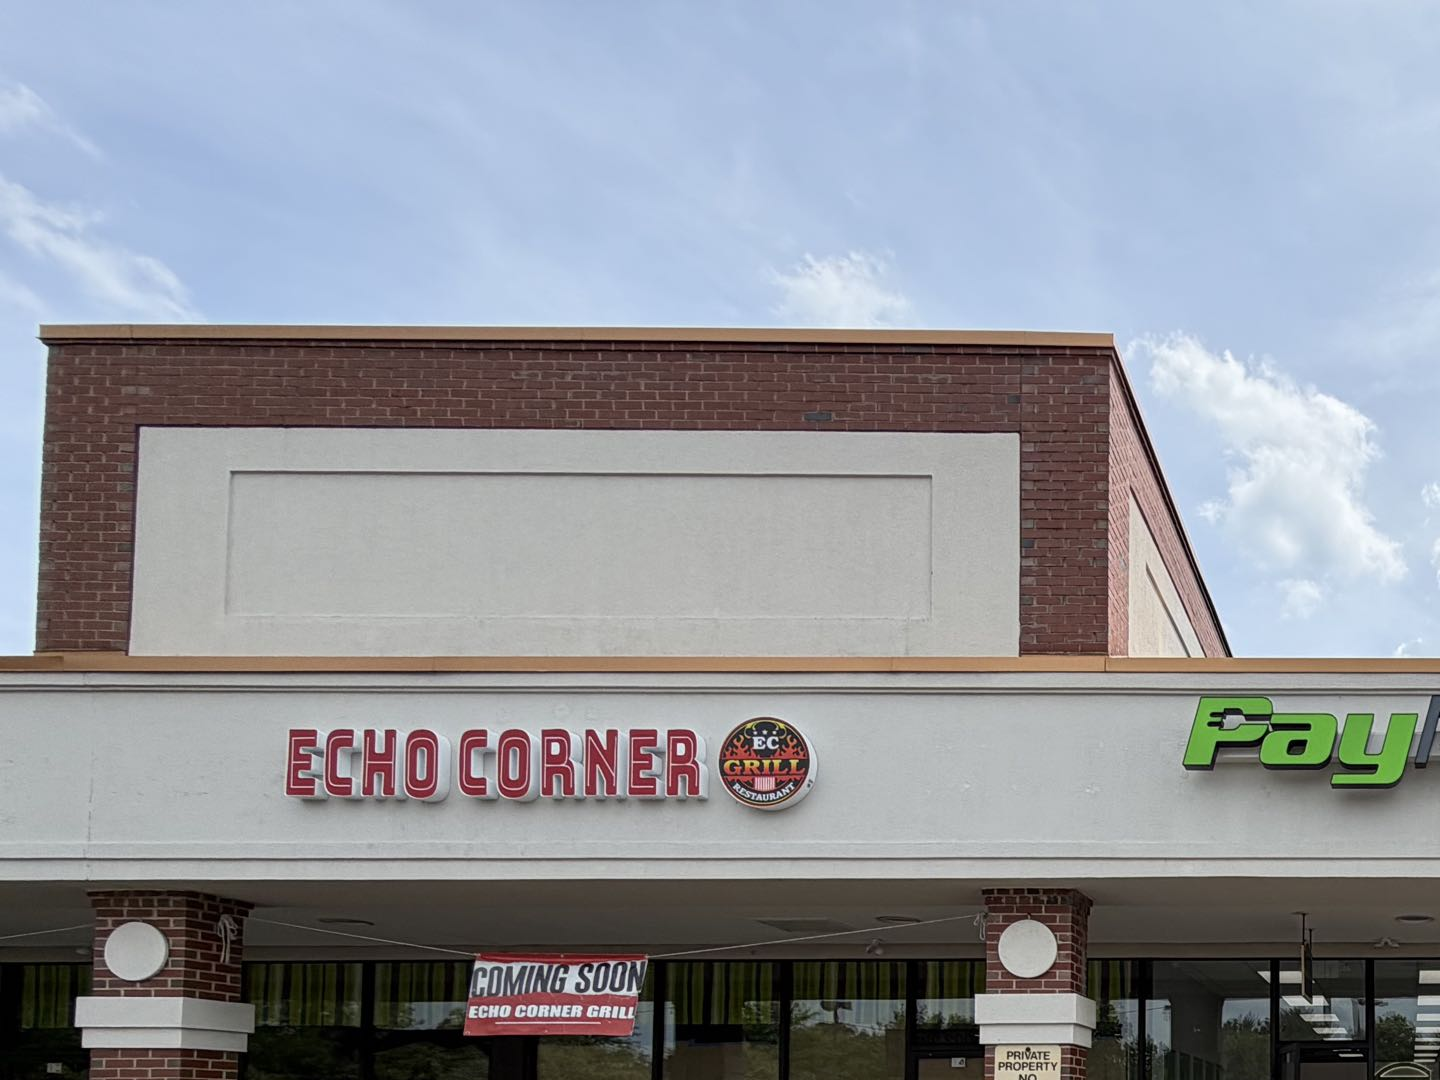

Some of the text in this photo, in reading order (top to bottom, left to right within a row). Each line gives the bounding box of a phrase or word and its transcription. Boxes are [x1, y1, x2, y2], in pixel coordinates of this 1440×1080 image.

[752, 736, 780, 750] EC
[284, 728, 702, 798] ECHO CORNER
[723, 759, 806, 775] GRILL
[732, 782, 796, 802] RESTAURANT
[471, 960, 648, 998] COMING SOON
[468, 1004, 636, 1019] ECHO CORNER GRILL
[1006, 1051, 1051, 1061] PRIVATE
[998, 1062, 1058, 1072] PROPERTY
